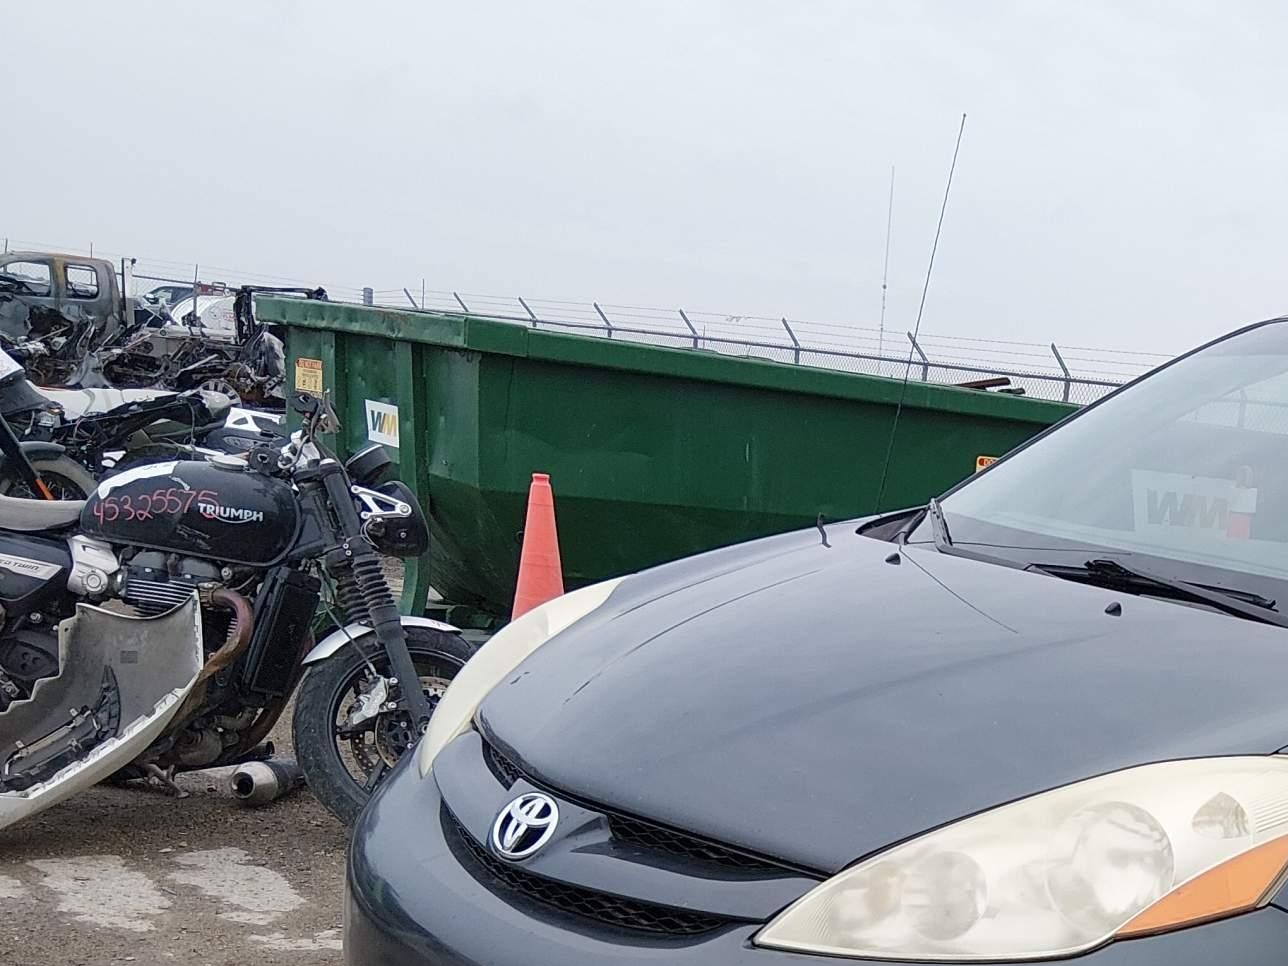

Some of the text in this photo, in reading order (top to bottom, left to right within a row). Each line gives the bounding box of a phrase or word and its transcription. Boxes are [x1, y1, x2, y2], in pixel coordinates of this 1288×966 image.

[370, 409, 397, 437] WM
[93, 487, 219, 525] 45325575
[197, 502, 264, 524] TRIUMPH
